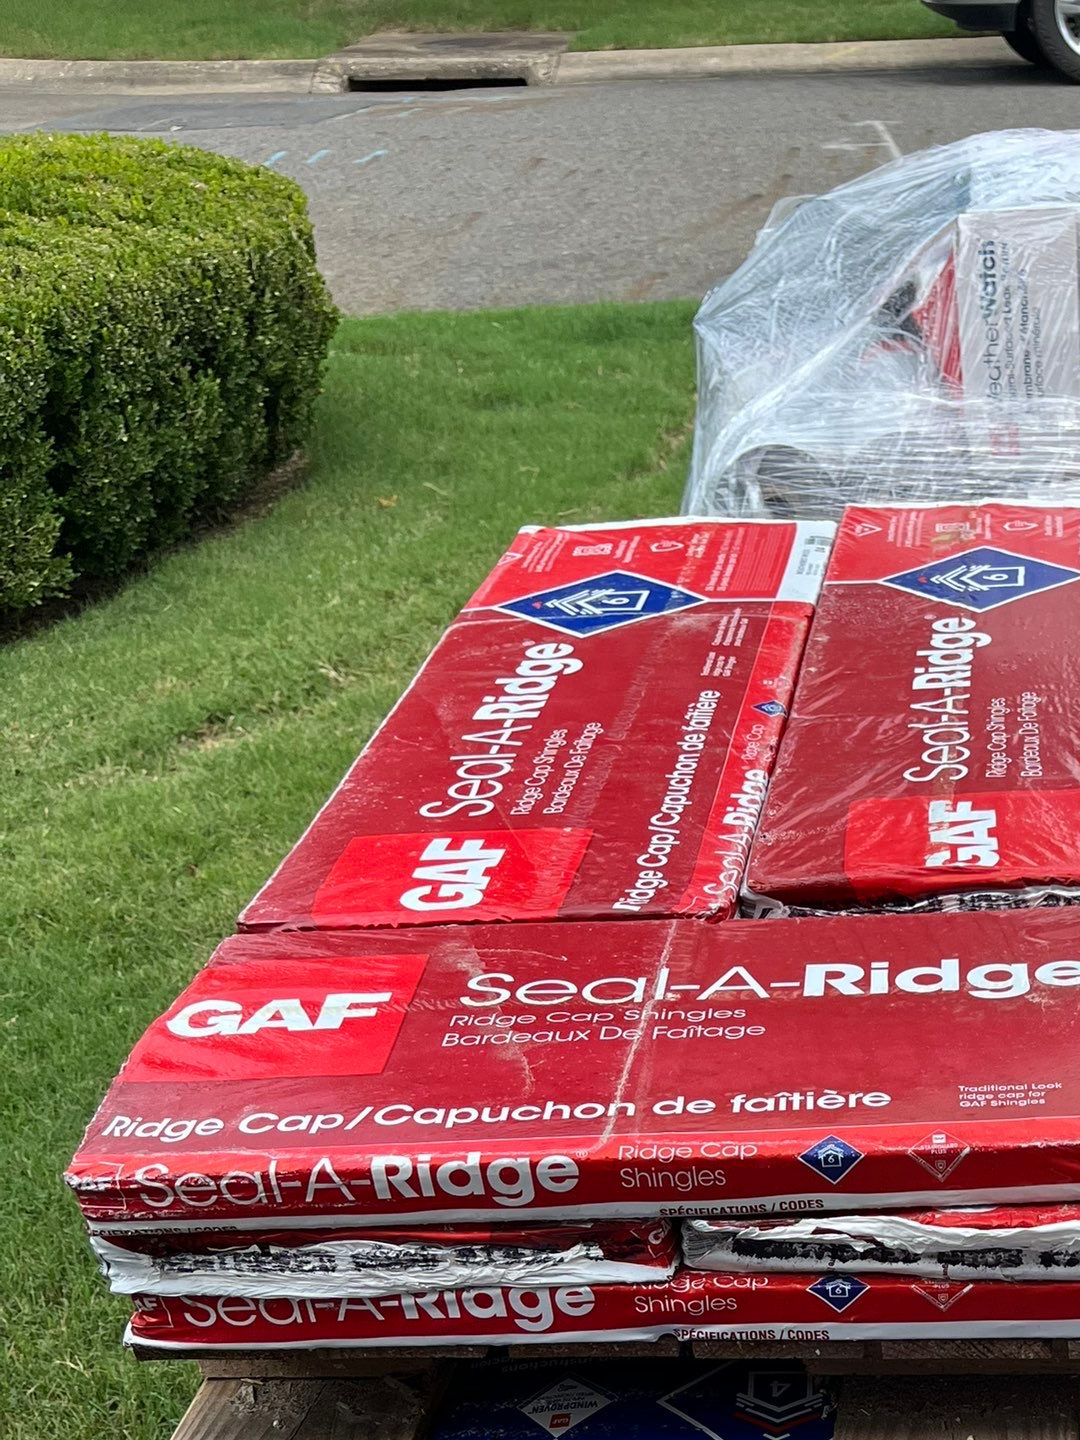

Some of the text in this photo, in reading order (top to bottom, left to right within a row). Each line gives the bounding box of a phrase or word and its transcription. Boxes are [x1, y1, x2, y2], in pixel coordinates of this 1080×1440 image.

[612, 870, 668, 910] Ridge
[681, 728, 706, 752] de
[399, 837, 506, 913] GAF
[165, 991, 394, 1038] GAF
[449, 1004, 748, 1029] Ridge Cap Shingles
[441, 1029, 591, 1048] Bardeaux
[599, 1026, 641, 1042] De
[958, 1081, 1062, 1093] Traditional Look
[959, 1090, 1046, 1101] ridge cap for
[990, 1098, 1046, 1107] Shingles
[102, 1088, 892, 1143] Ridge Cap/Capuchon de faîtière
[617, 1141, 759, 1166] Ridge Cap
[620, 1164, 728, 1195] Shingles
[779, 1200, 824, 1212] CODES
[634, 1293, 737, 1316] Shingles
